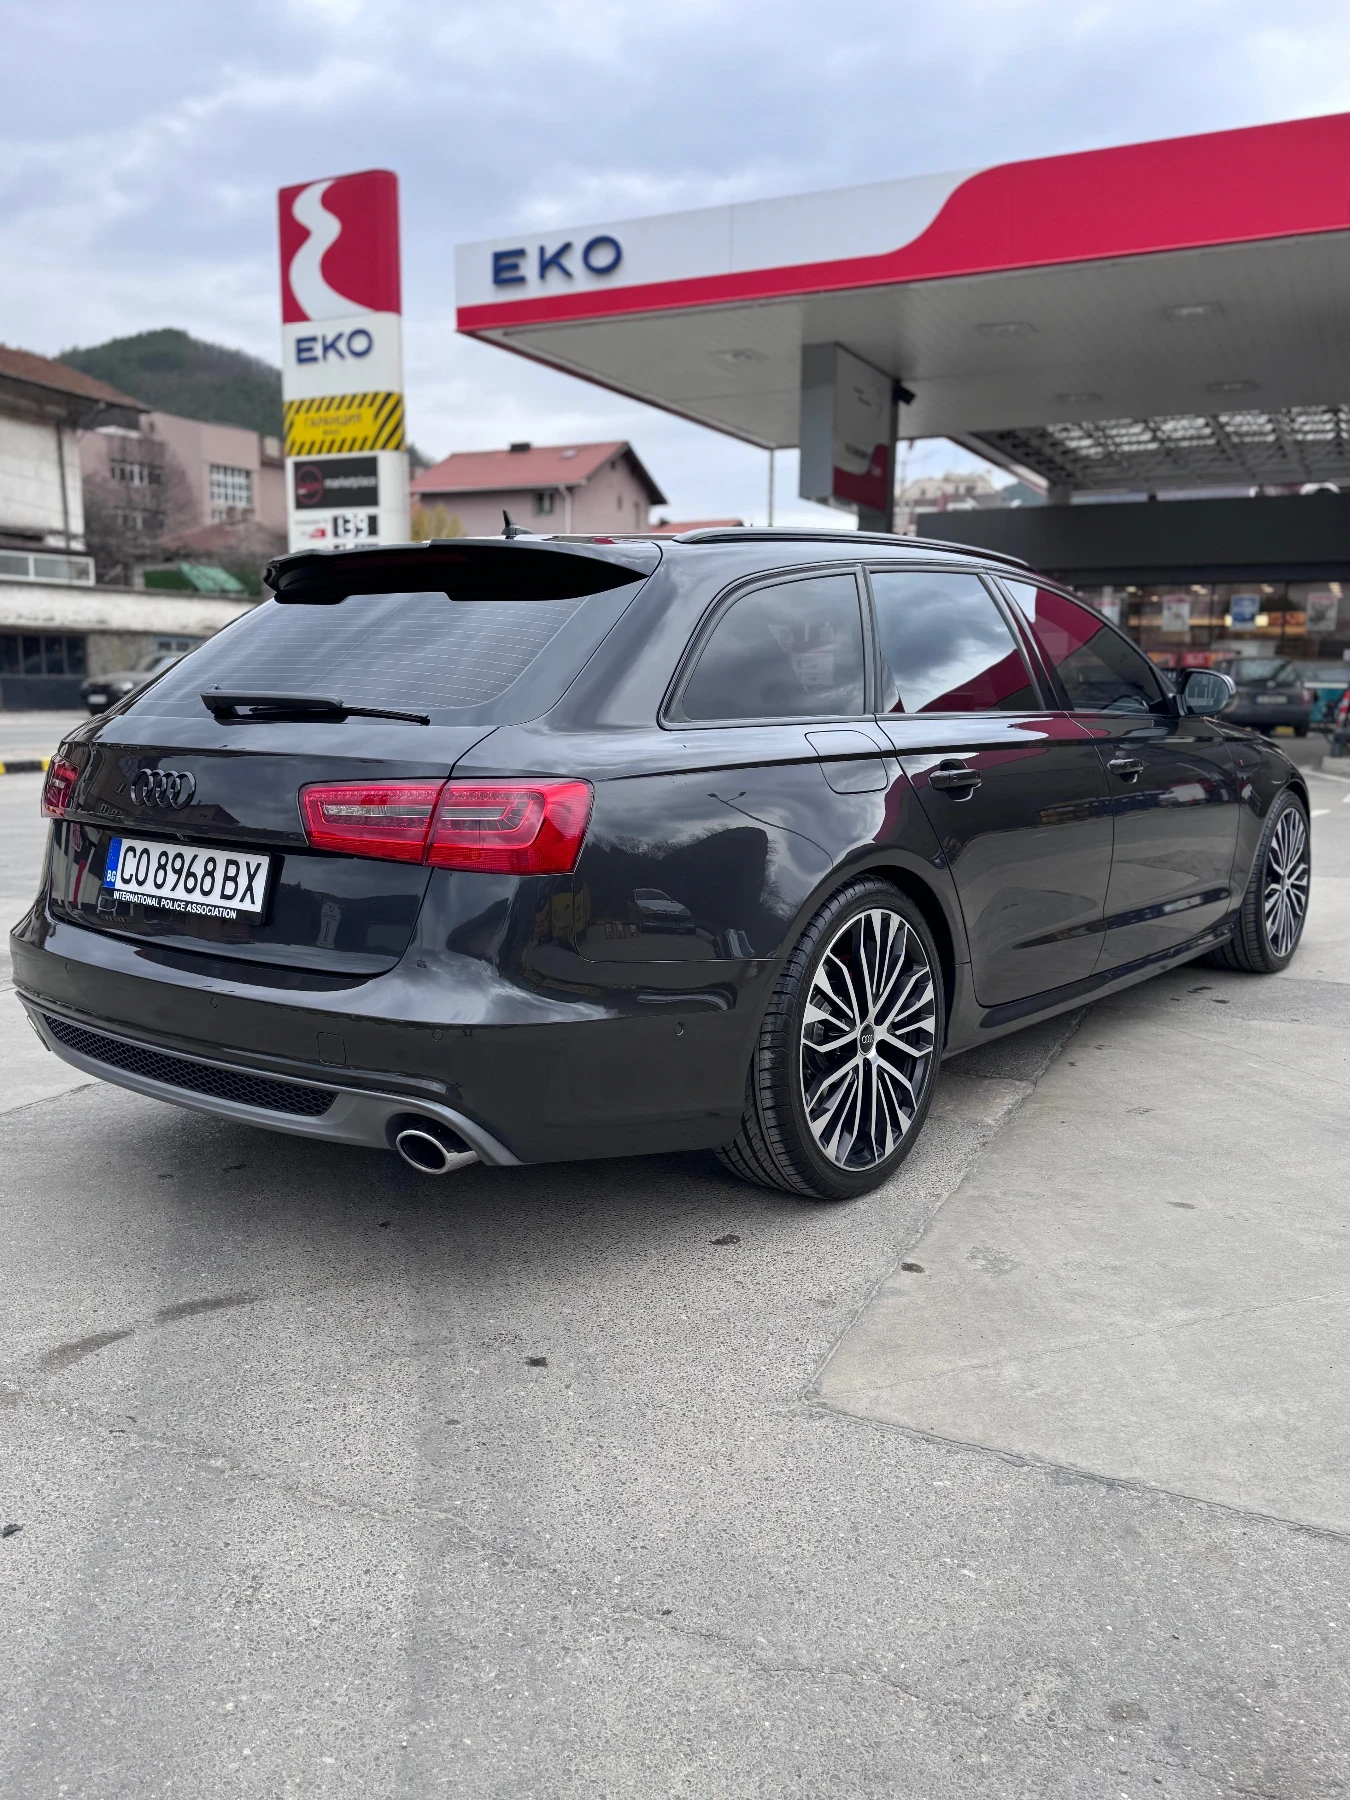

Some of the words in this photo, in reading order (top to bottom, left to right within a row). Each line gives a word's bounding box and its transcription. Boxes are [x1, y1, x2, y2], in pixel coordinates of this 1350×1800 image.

[492, 235, 622, 285] EKO
[296, 329, 373, 364] EKO
[106, 869, 117, 882] BG
[113, 890, 160, 908] INTERNATIONAL
[160, 898, 185, 912] POLICE
[186, 905, 237, 920] ASSOCIATION
